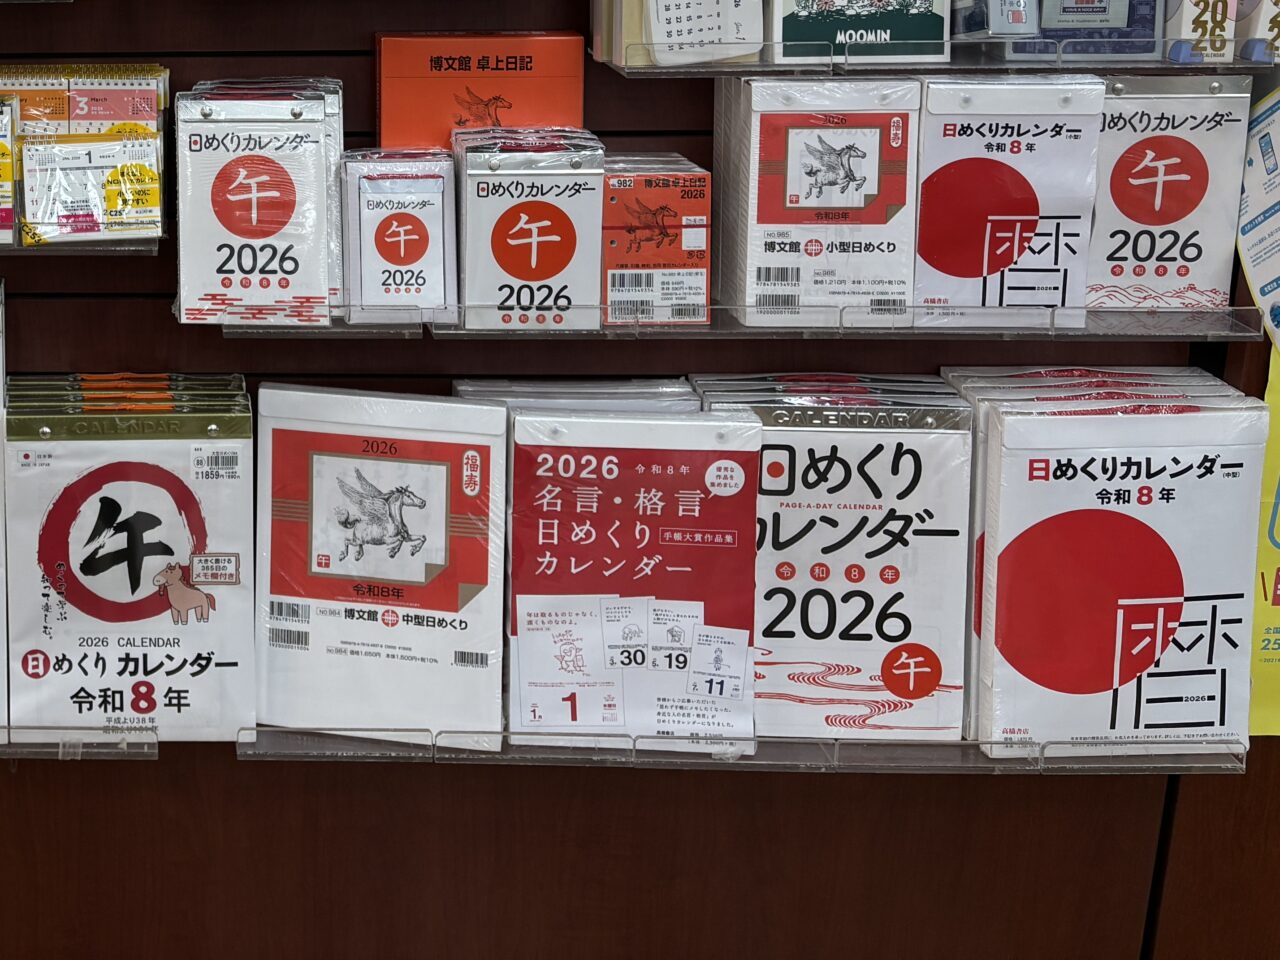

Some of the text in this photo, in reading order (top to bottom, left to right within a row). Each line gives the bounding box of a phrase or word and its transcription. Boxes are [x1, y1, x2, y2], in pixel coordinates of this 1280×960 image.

[835, 29, 892, 45] MOOMIN
[429, 56, 533, 72] 博文館 卓上日記
[942, 122, 1082, 138] 日めくりカレンダー
[188, 132, 320, 152] 日めくりカレンダー
[476, 180, 597, 198] 日めくりカレンダー
[1128, 149, 1192, 211] 午
[366, 199, 436, 211] 日めくりカレンダー
[814, 211, 850, 221] 令和8年
[764, 241, 897, 254] 博文館 小型日めくり
[1106, 229, 1204, 263] 2026
[215, 243, 300, 276] 2026
[381, 269, 427, 287] 2026
[497, 283, 573, 312] 2026
[463, 454, 480, 492] 福寿
[758, 442, 922, 501] 日めくり
[1028, 454, 1245, 482] 日めくりカレンダー
[533, 484, 707, 518] 名言・格言
[780, 502, 884, 511] PAGE-A-DAY CALENDAR
[537, 518, 652, 549] 日めくり
[79, 496, 175, 596] 午
[195, 572, 236, 581] メモ欄付き
[534, 551, 693, 581] カレンダー
[352, 583, 405, 601] 令和8年
[343, 607, 469, 631] 博文館 中型日めくり
[762, 587, 912, 643] 2026
[78, 637, 181, 649] 2026 CALENDAR
[619, 649, 647, 667] 30
[664, 652, 688, 671] 19
[891, 650, 932, 692] 午
[70, 680, 191, 716] 令和8年
